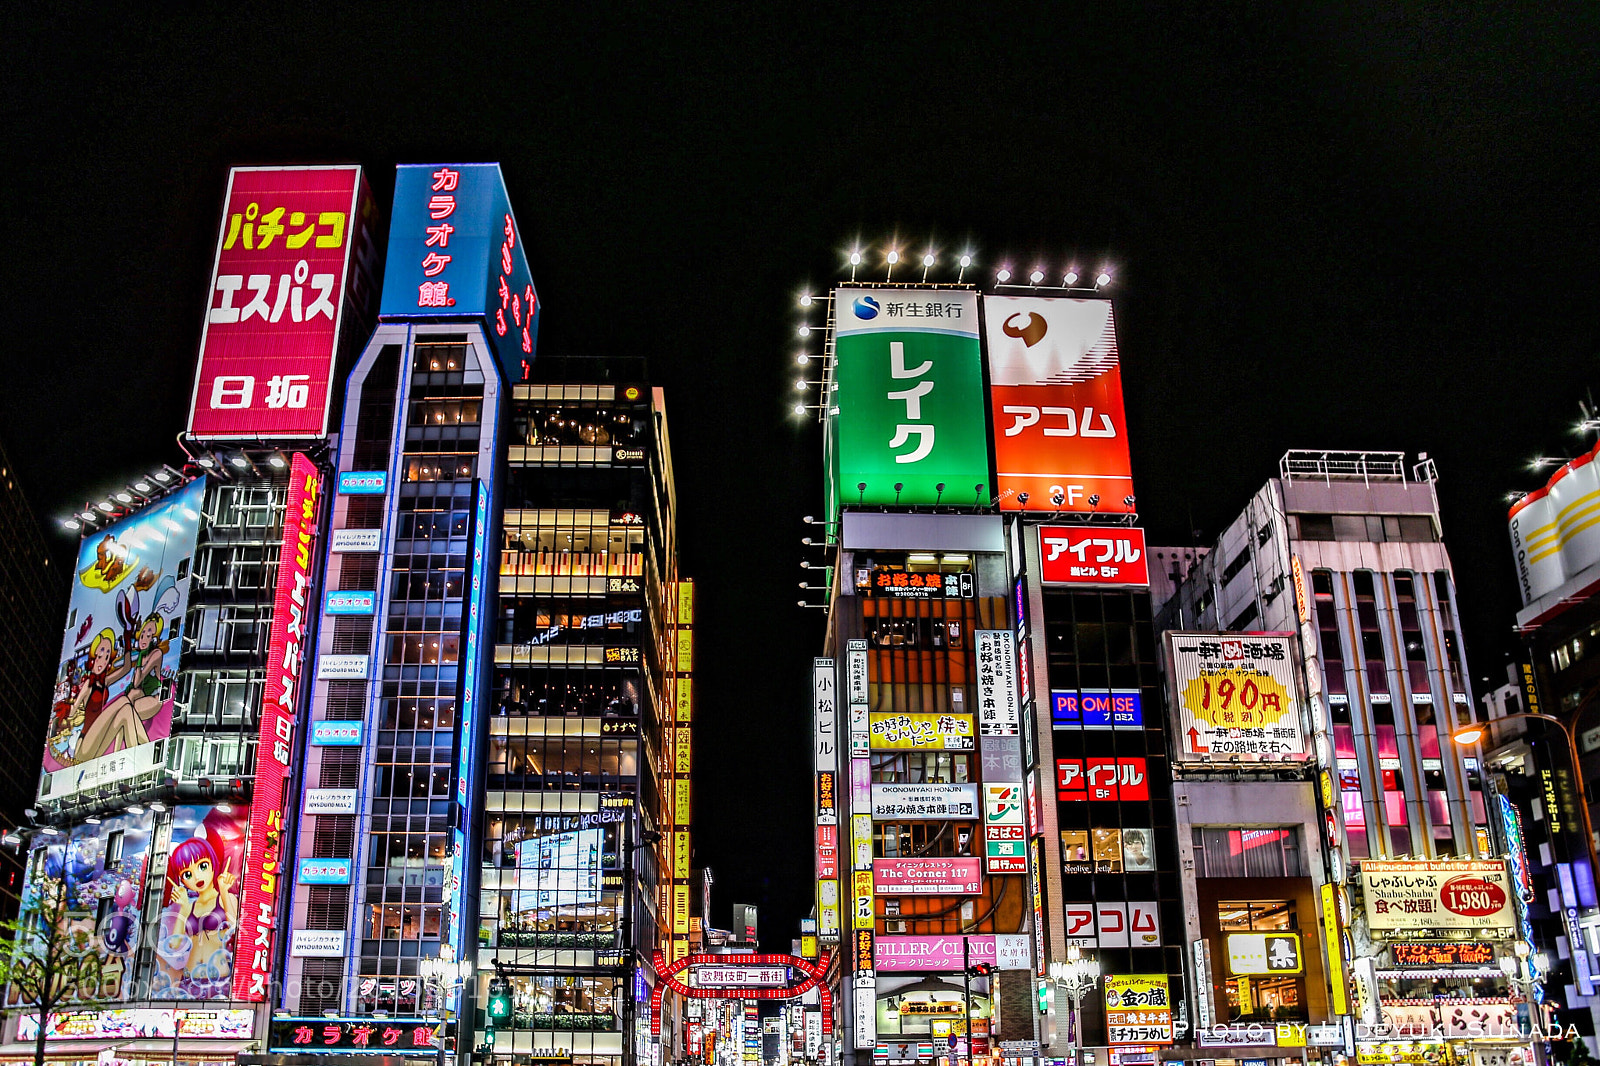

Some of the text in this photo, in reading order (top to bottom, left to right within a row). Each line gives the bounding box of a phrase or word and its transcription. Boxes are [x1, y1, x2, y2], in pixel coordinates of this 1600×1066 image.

[223, 202, 346, 250] パチンコ
[209, 259, 335, 324] エスパス
[886, 301, 963, 319] 新生銀行
[887, 341, 936, 464] レイク
[1002, 405, 1117, 438] アコム
[1044, 537, 1141, 564] アイフル
[1512, 519, 1532, 601] Don Quijote
[877, 573, 942, 588] お好み焼
[1101, 566, 1119, 578] 5F
[279, 570, 305, 713] エスパス
[1202, 677, 1281, 712] 190円
[1057, 697, 1134, 713] PROMISE
[818, 677, 833, 755] 小松ビル
[871, 715, 911, 734] お好み
[937, 715, 969, 734] 焼き
[1211, 740, 1292, 753] 左の路地を右へ
[1059, 764, 1143, 786] アイフル
[1096, 788, 1110, 799] 5F
[960, 804, 972, 814] 2F
[998, 843, 1014, 855] 酒
[302, 867, 347, 875] カラオケ館
[823, 868, 834, 876] 4F
[880, 869, 968, 878] The Corner 117
[989, 860, 1025, 870] 銀行ATM
[1365, 862, 1503, 872] All-you-can-eat buffet for 2 hours
[966, 883, 978, 892] 4F
[1369, 875, 1438, 888] しゃぶしゃぶ
[1370, 888, 1438, 899] "Shabu-Shabu"
[1449, 891, 1490, 912] 1,980
[1374, 899, 1437, 914] 食べ放題!
[1067, 909, 1156, 934] アコム
[249, 902, 273, 996] エスパス
[859, 930, 872, 970] お好み焼
[876, 942, 930, 956] FILLER
[875, 958, 950, 967] フィラー クリニック
[701, 970, 782, 982] 歌舞伎町一番街
[360, 979, 416, 997] ダーツ
[1121, 988, 1167, 1007] 金の蔵
[293, 1026, 433, 1046] カラオケ館
[1116, 1027, 1170, 1042] チカラめし
